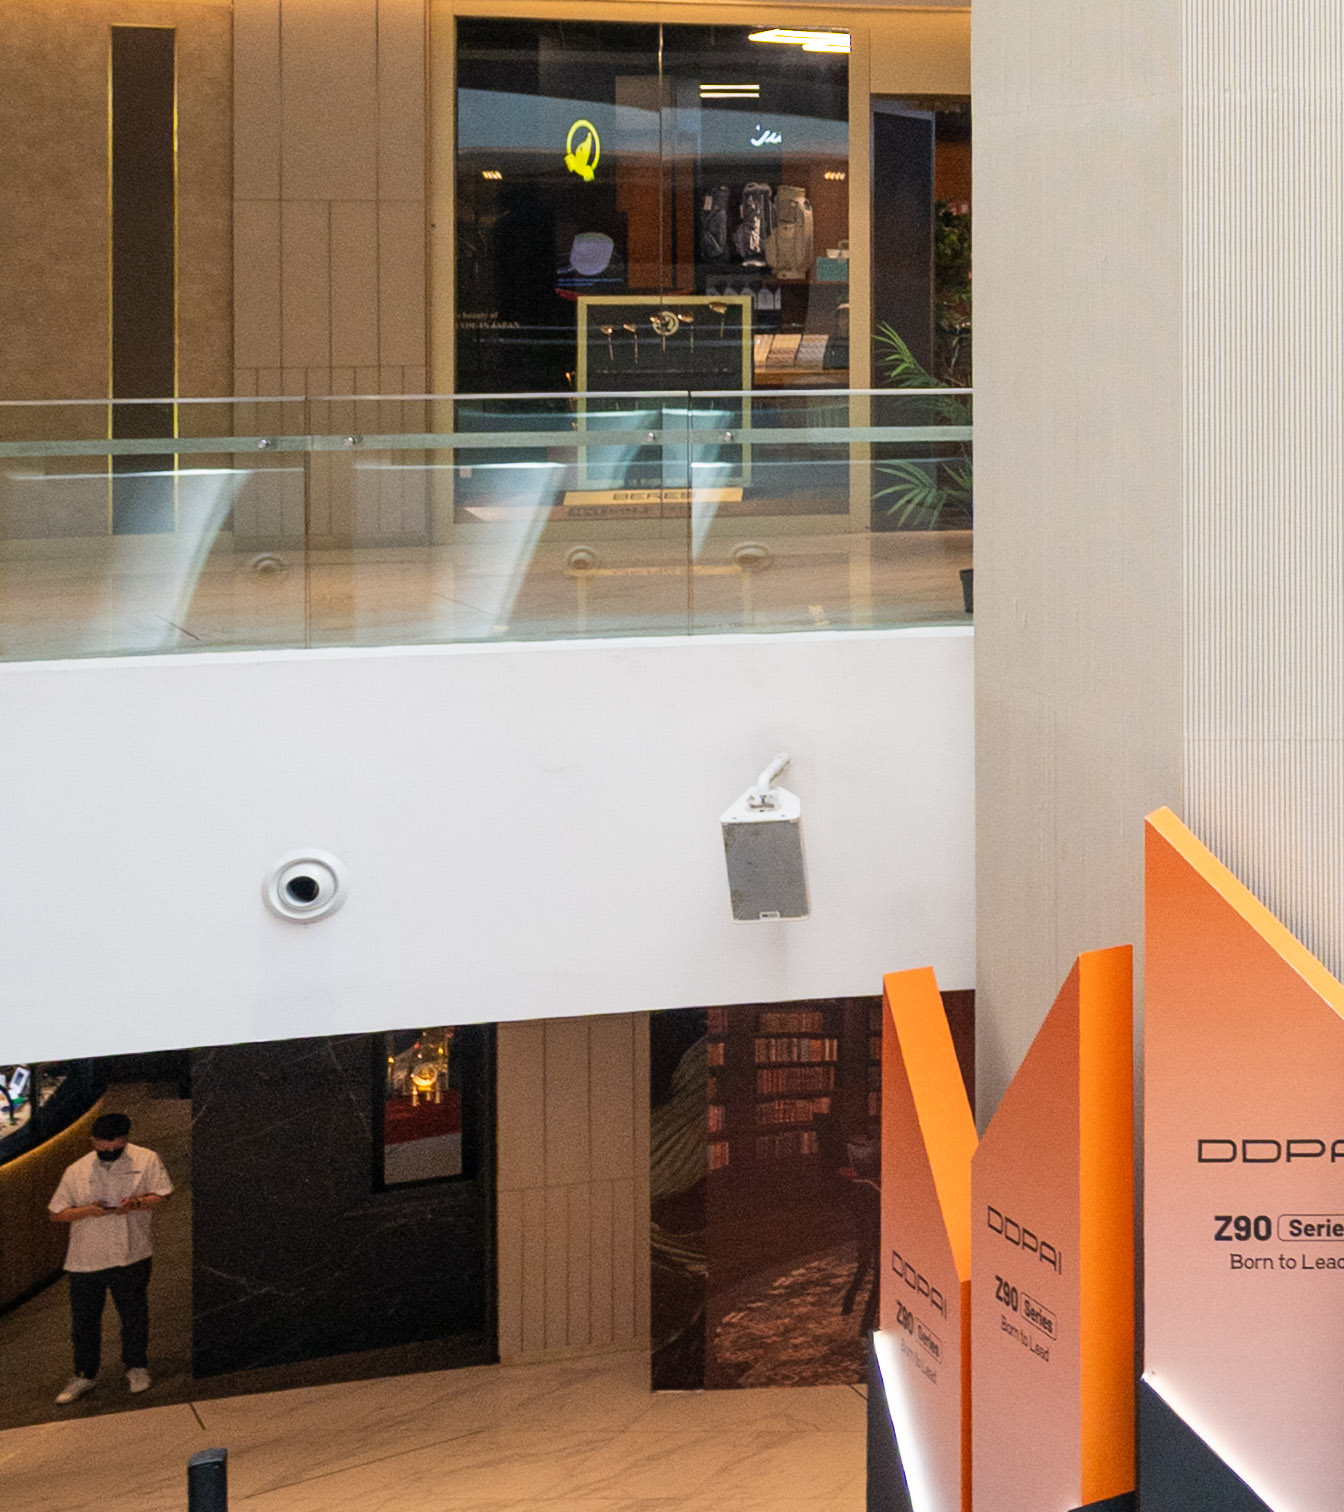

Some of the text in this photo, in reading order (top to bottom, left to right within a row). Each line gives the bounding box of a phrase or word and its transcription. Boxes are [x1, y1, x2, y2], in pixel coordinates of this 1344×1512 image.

[987, 1205, 1062, 1276] DDPAI
[1214, 1215, 1272, 1242] Z90
[892, 1249, 947, 1321] DDPAI
[1229, 1253, 1274, 1270] Born
[1279, 1254, 1297, 1270] to
[896, 1299, 914, 1336] Z90
[995, 1274, 1053, 1335] Z90 Series
